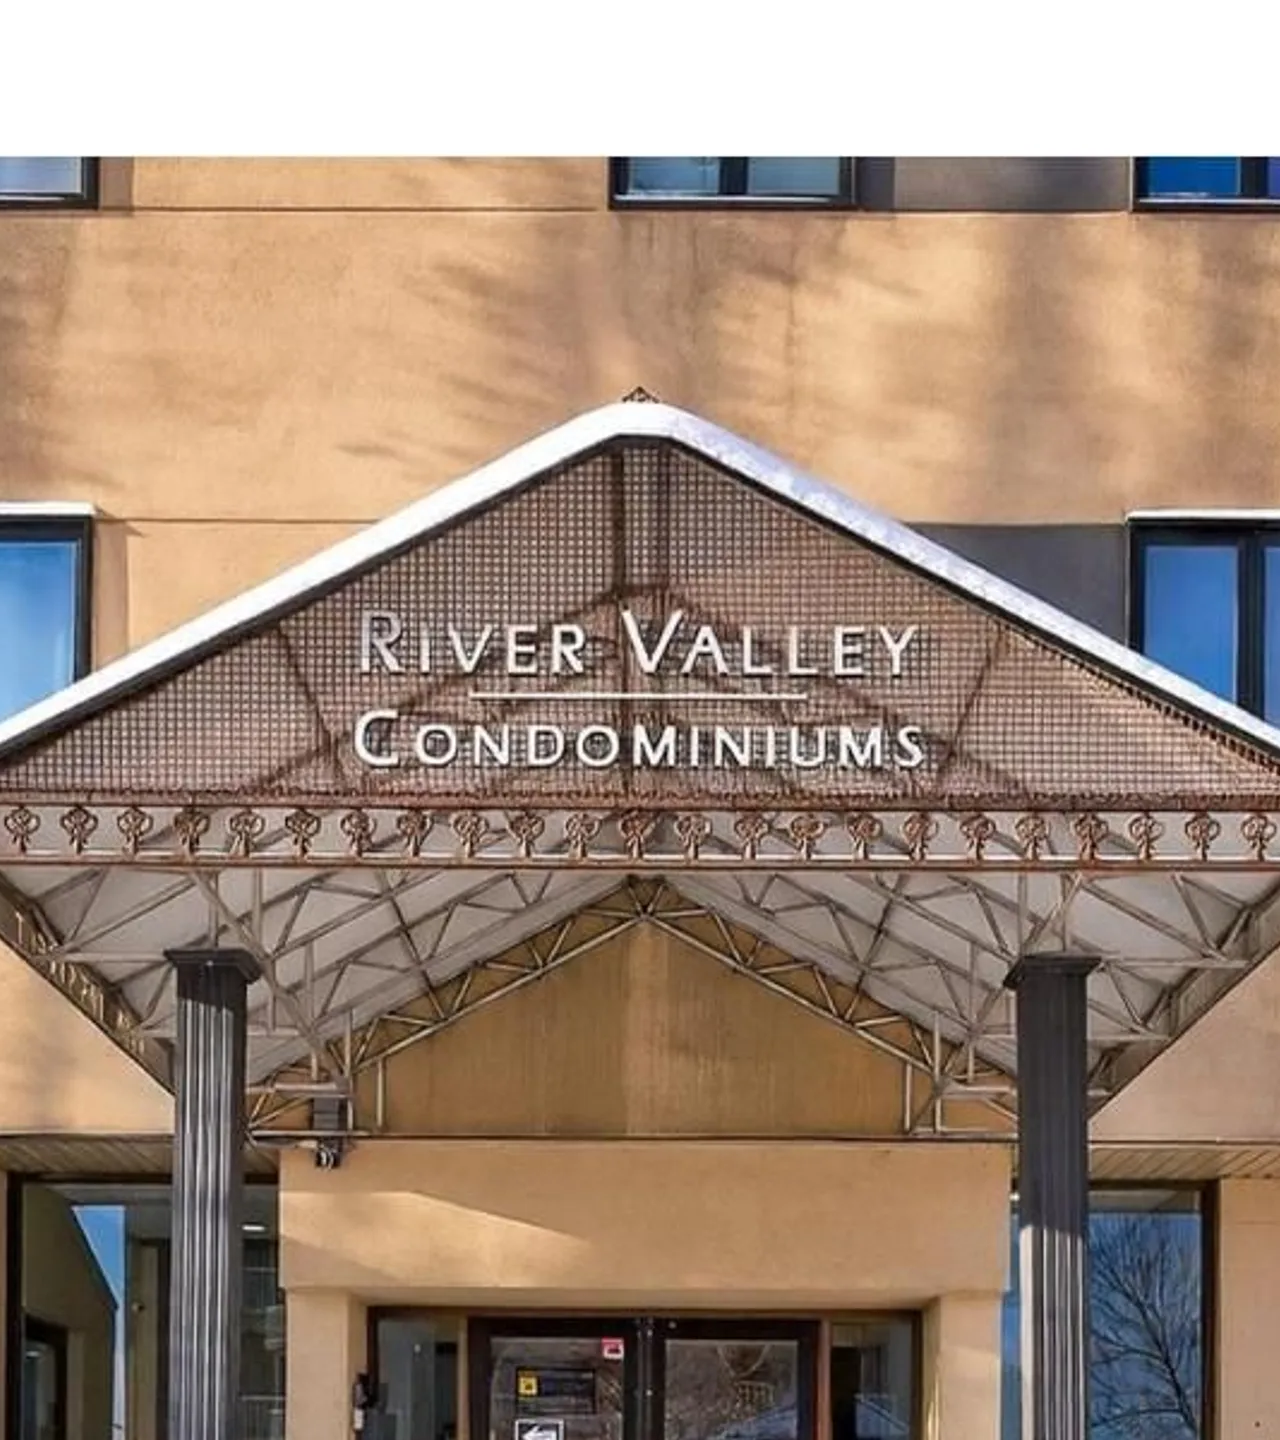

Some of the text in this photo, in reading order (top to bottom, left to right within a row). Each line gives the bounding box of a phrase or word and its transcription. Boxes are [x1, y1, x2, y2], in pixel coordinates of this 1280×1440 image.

[360, 609, 919, 676] RIVER VALLEY
[354, 709, 925, 768] CONDOMINIUMS
